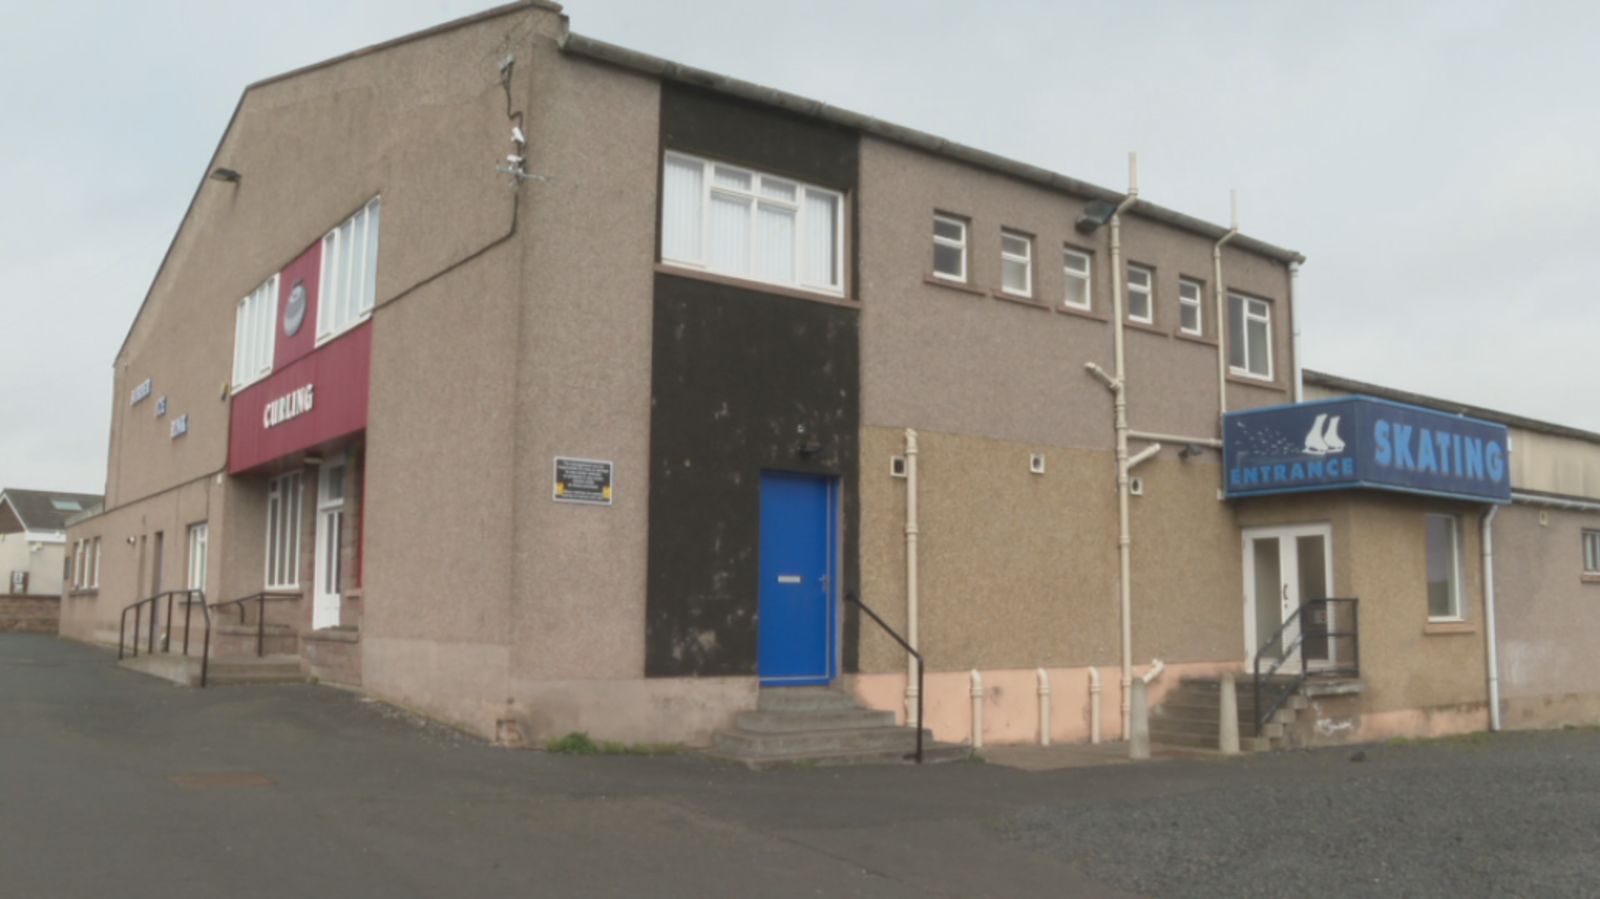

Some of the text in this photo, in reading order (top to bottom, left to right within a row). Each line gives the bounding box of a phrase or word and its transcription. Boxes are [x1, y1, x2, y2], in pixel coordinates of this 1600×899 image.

[263, 384, 314, 428] CURLING
[1231, 458, 1353, 485] ENTRANCE
[1375, 419, 1504, 482] SKATING
